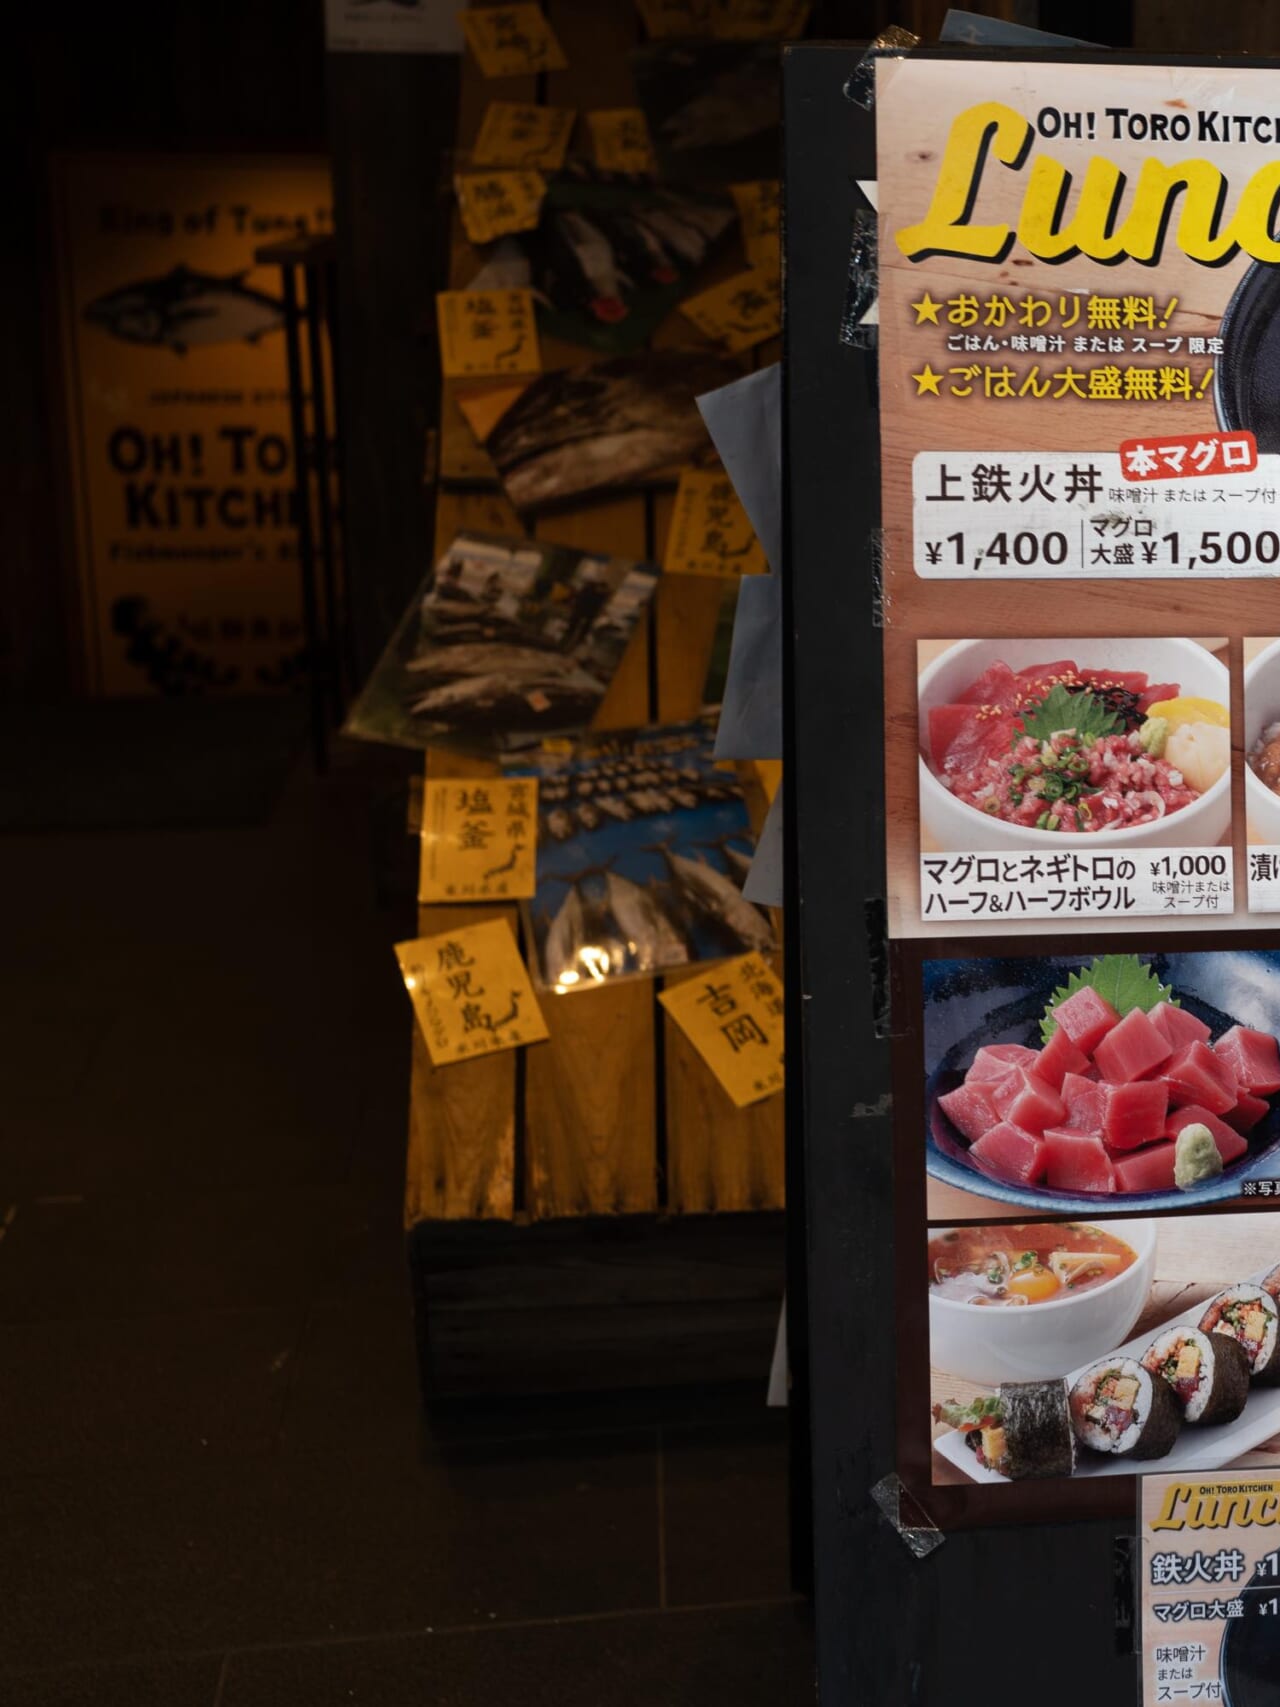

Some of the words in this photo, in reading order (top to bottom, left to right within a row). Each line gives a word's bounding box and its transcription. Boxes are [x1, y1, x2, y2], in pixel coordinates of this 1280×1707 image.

[1105, 108, 1190, 141] TORO
[1073, 335, 1125, 354] または
[1132, 336, 1182, 355] スープ
[1188, 337, 1225, 355] 限定
[1125, 438, 1251, 477] 本マグロ
[925, 463, 1104, 504] 上鉄火丼
[1108, 487, 1158, 504] 味噌汁
[1164, 488, 1206, 503] または
[1212, 487, 1276, 504] スープ付
[1090, 518, 1152, 538] マグロ
[925, 531, 1068, 571] ¥1,400
[1090, 543, 1134, 566] 大盛
[1142, 530, 1280, 570] ¥1,500
[923, 853, 1136, 885] マグロとネギトロの
[1150, 855, 1226, 879] ¥1,000
[925, 885, 1135, 915] ハーフ&ハーフボウル
[1152, 880, 1231, 894] 味噌汁または
[1163, 894, 1218, 910] スープ付
[438, 941, 496, 1033] 鹿児島
[696, 984, 768, 1053] 吉岡
[1152, 1551, 1243, 1584] 鉄火丼
[1154, 1600, 1244, 1621] マグロ大盛
[1156, 1645, 1206, 1663] 味噌汁
[1158, 1667, 1193, 1680] または
[1158, 1682, 1221, 1700] スープ付
